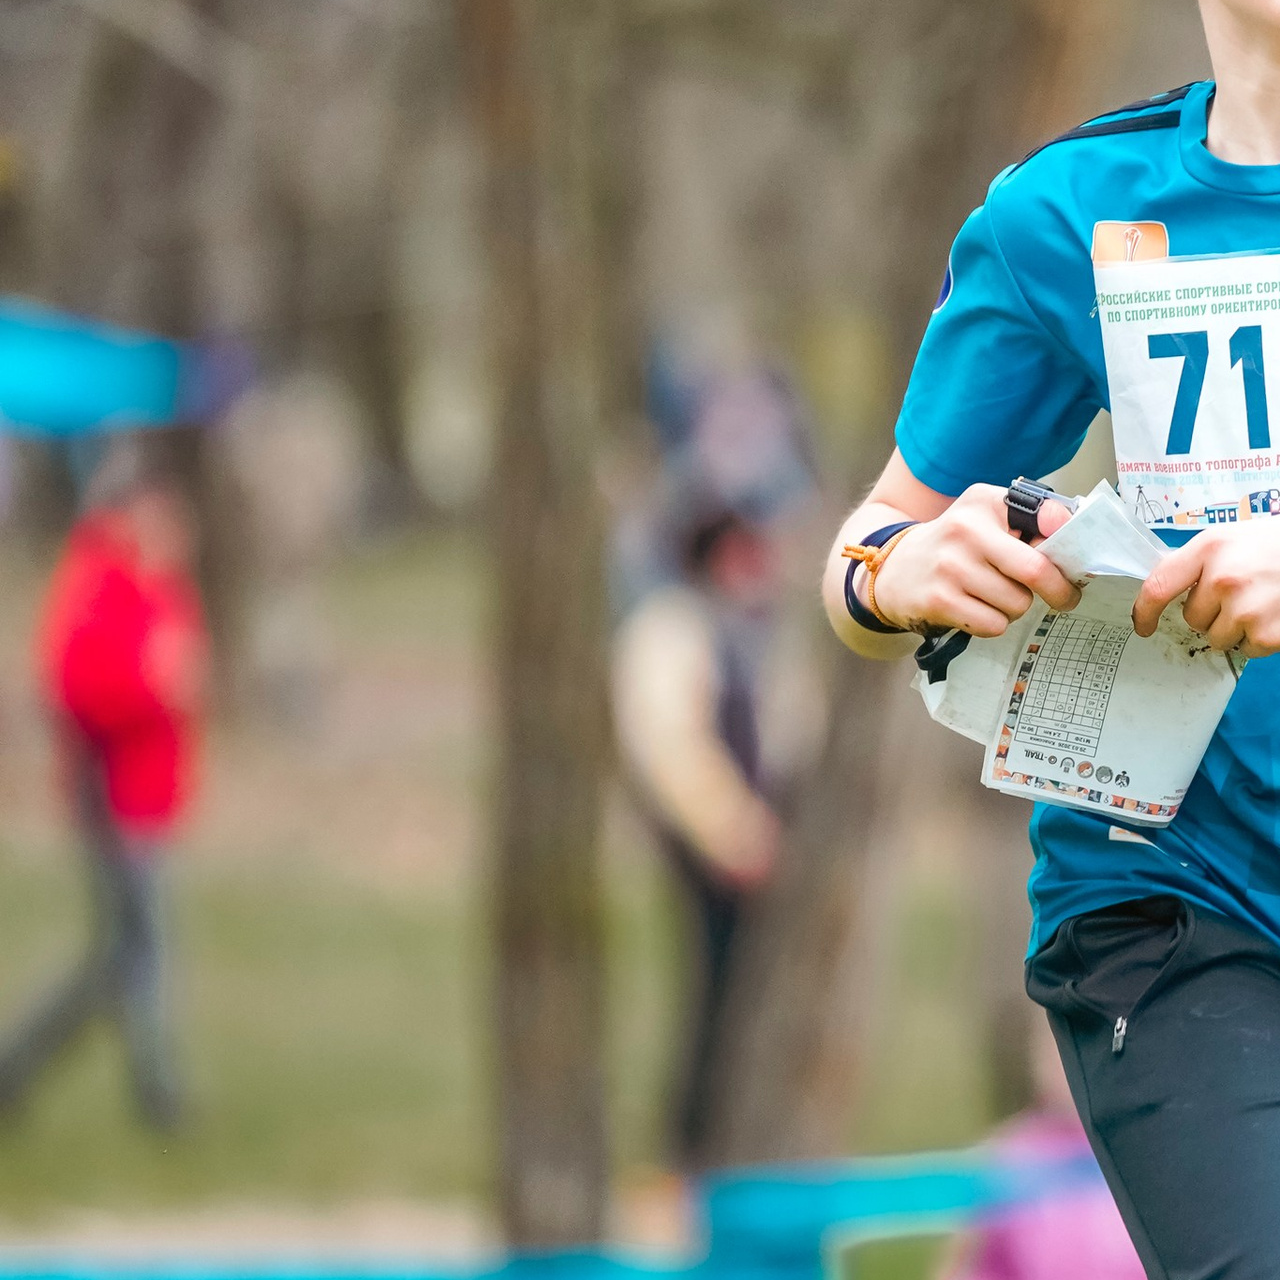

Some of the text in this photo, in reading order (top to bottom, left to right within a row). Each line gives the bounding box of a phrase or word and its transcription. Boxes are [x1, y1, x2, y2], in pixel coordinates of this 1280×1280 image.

[1097, 289, 1171, 307] РОССИЙСКИЕ
[1175, 283, 1253, 300] СПОРТИВНЫЕ
[1107, 311, 1121, 323] ПО
[1124, 304, 1207, 322] СПОРТИВНОМУ
[1147, 325, 1271, 455] 71
[1153, 461, 1202, 474] военного
[1206, 454, 1271, 472] топографа
